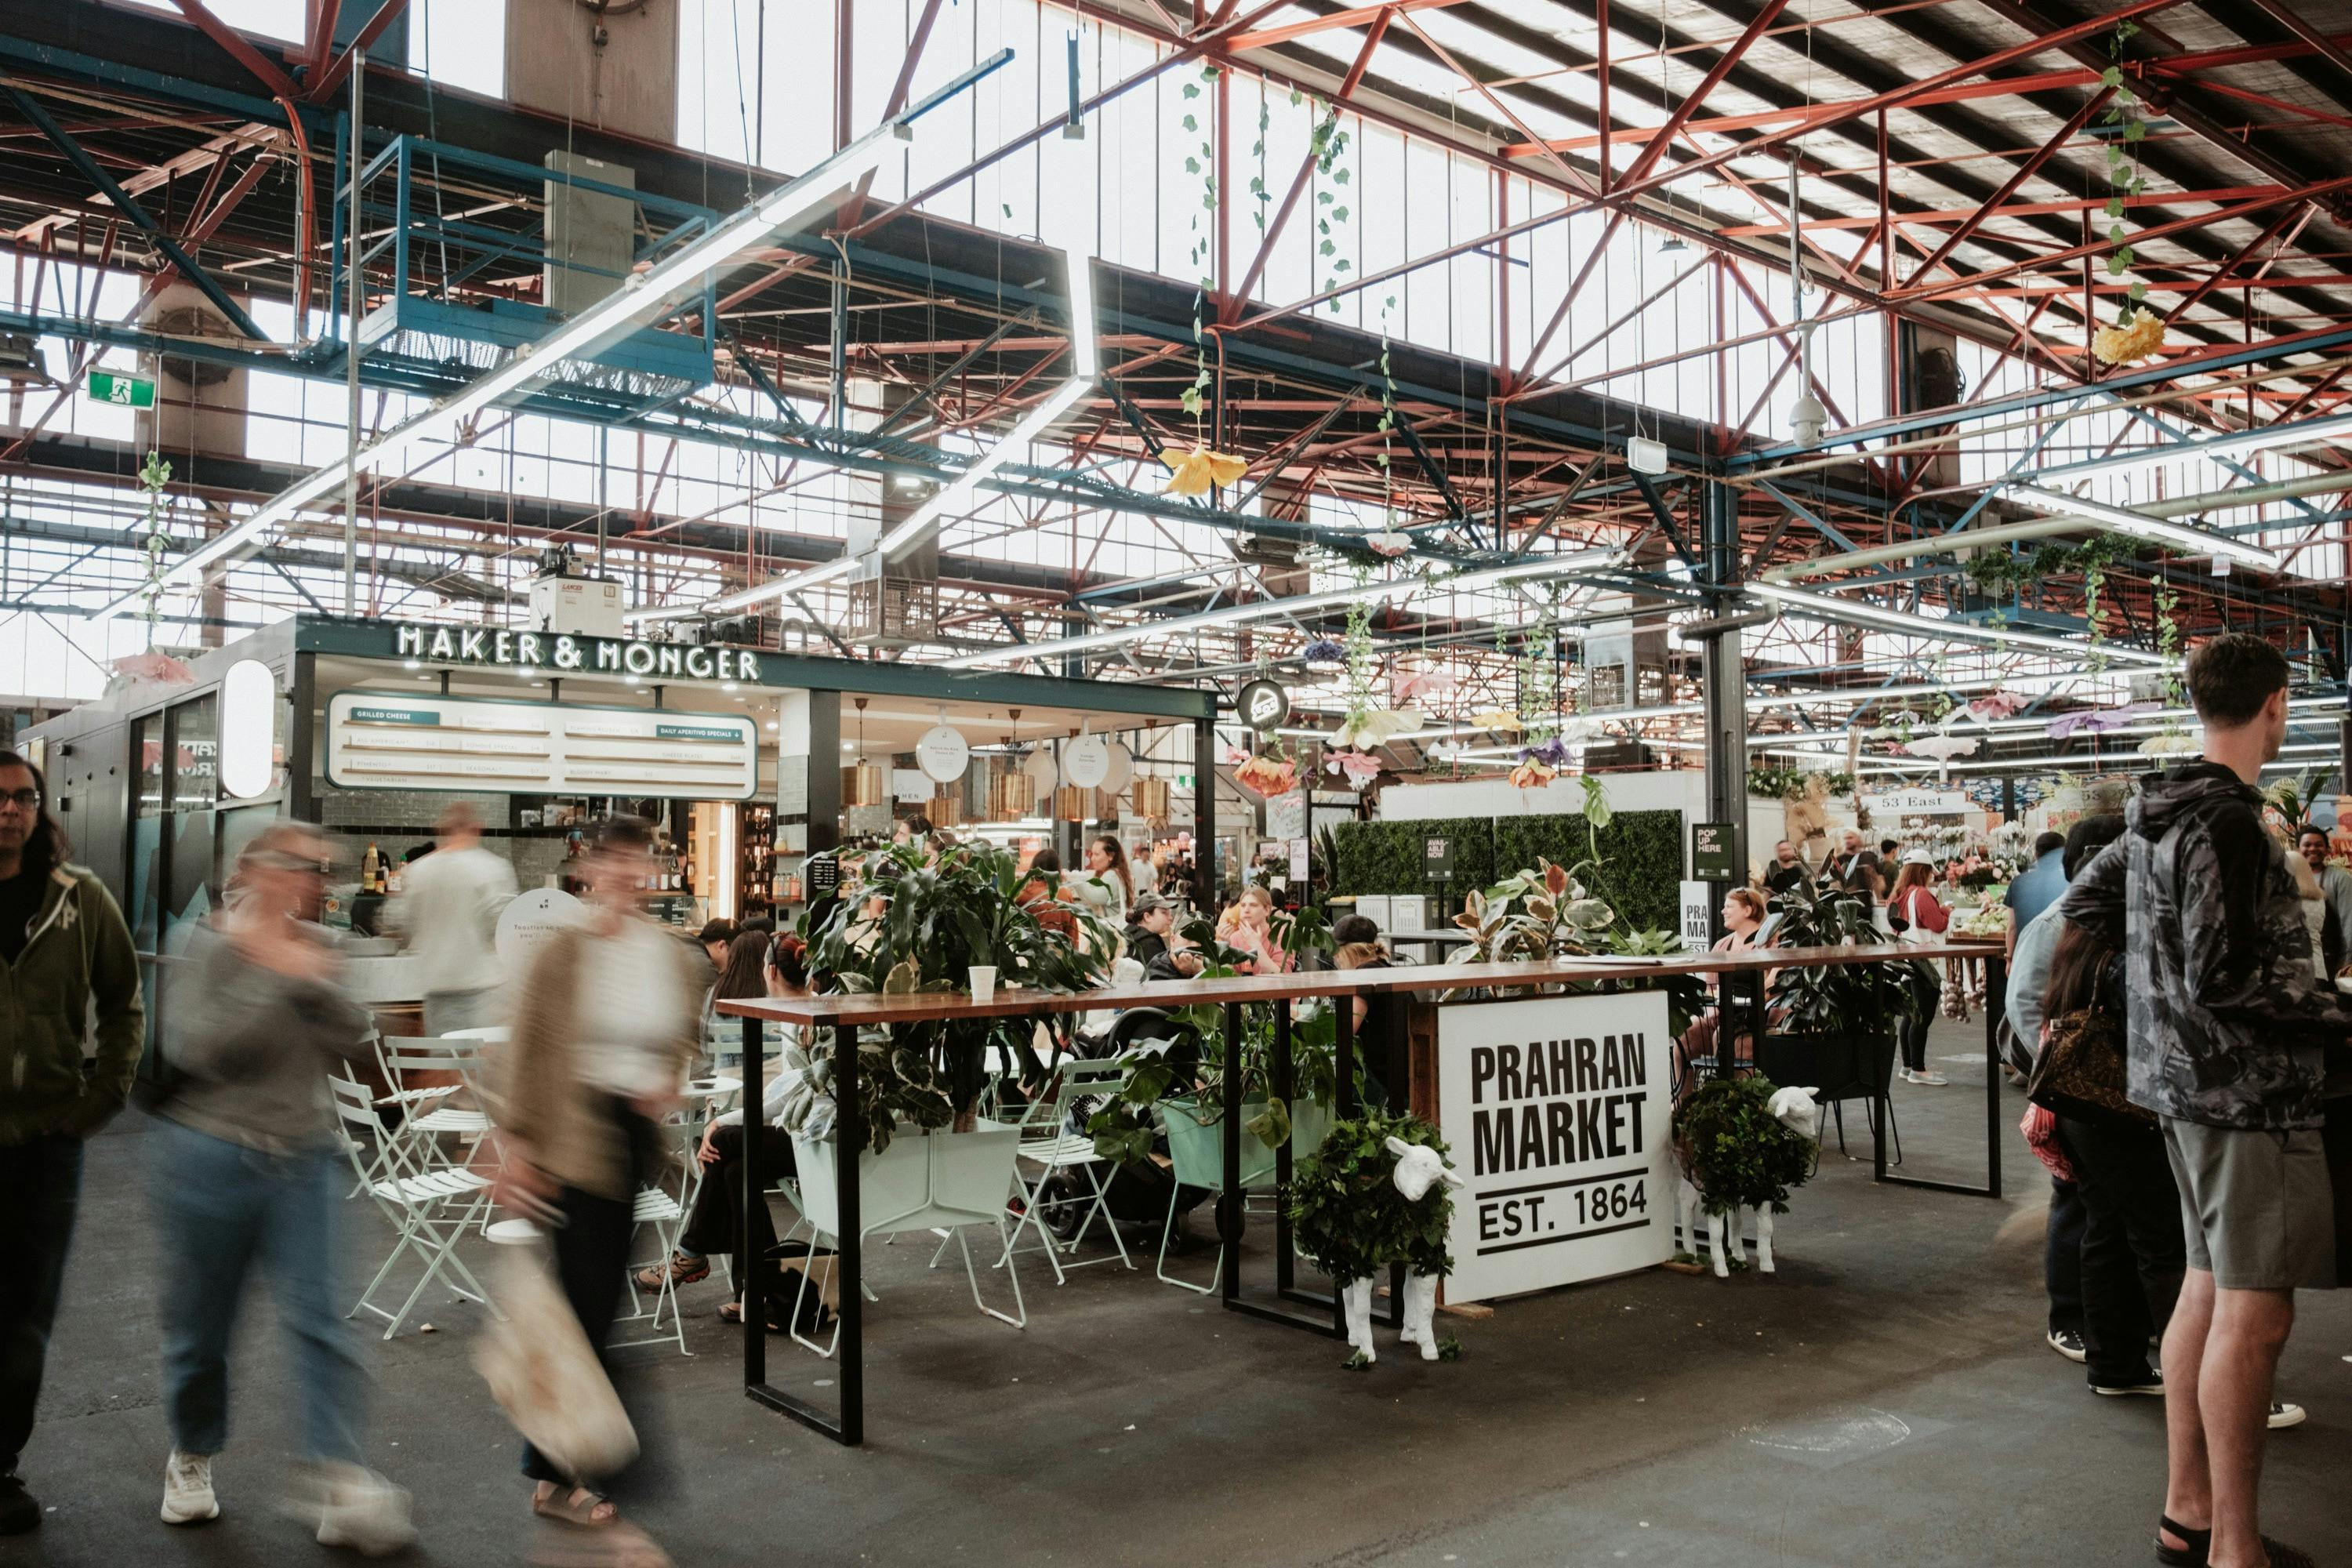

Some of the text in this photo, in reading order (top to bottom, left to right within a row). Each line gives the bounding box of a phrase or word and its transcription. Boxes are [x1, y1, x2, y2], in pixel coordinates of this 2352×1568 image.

[397, 626, 759, 680] MAKER & MONGER
[1907, 797, 1943, 807] East
[1686, 905, 1708, 919] PRA
[1687, 921, 1707, 938] MA
[1471, 1033, 1646, 1104] PRAHRAN
[1473, 1091, 1647, 1176] MARKET
[1479, 1179, 1646, 1240] EST. 1864
